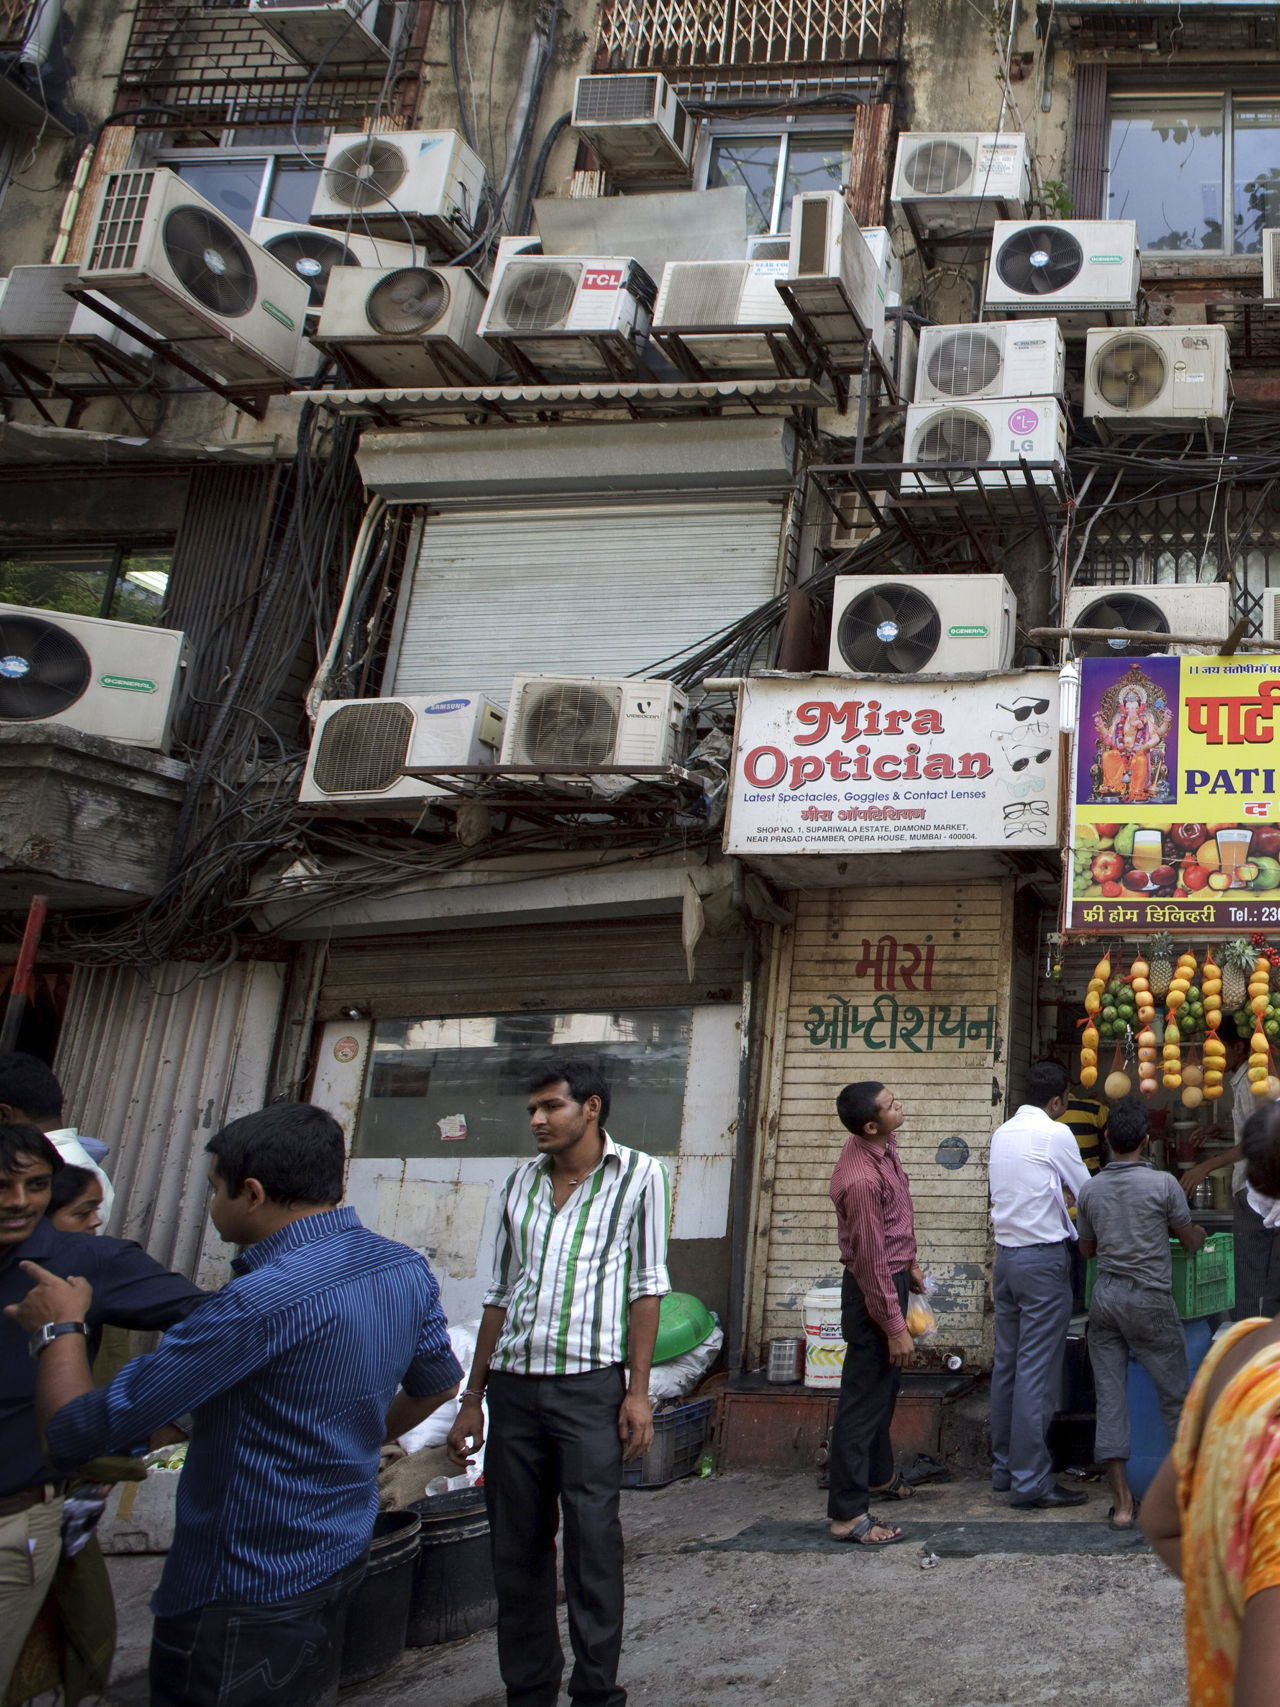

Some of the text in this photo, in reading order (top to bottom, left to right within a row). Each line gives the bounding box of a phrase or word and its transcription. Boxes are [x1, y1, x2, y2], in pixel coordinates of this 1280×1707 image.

[586, 274, 619, 286] TCL
[1010, 439, 1034, 452] LG
[1201, 665, 1220, 675] जय
[793, 700, 945, 745] Mira
[743, 743, 994, 791] Optician
[744, 790, 987, 803] Latest Spectacles, Goggles & Contact Lenses
[801, 805, 834, 822] मीरा
[1243, 801, 1273, 816] द
[756, 826, 780, 834] SHOP
[781, 826, 796, 834] NO.
[806, 825, 858, 834] SUPARIWALA
[859, 825, 892, 833] ESTATE,
[893, 824, 932, 832] DIAMOND
[933, 823, 969, 832] MARKET,
[746, 835, 769, 843] NEAR
[770, 835, 803, 843] PRASAD
[804, 835, 846, 843] CHAMBER,
[847, 834, 876, 842] OPERA
[878, 834, 908, 842] HOUSE,
[909, 833, 942, 841] MUMBAI
[1083, 904, 1105, 923] फ्री
[1108, 905, 1139, 923] होम
[1229, 907, 1258, 922] Tel.:
[855, 934, 936, 992] મીરાં
